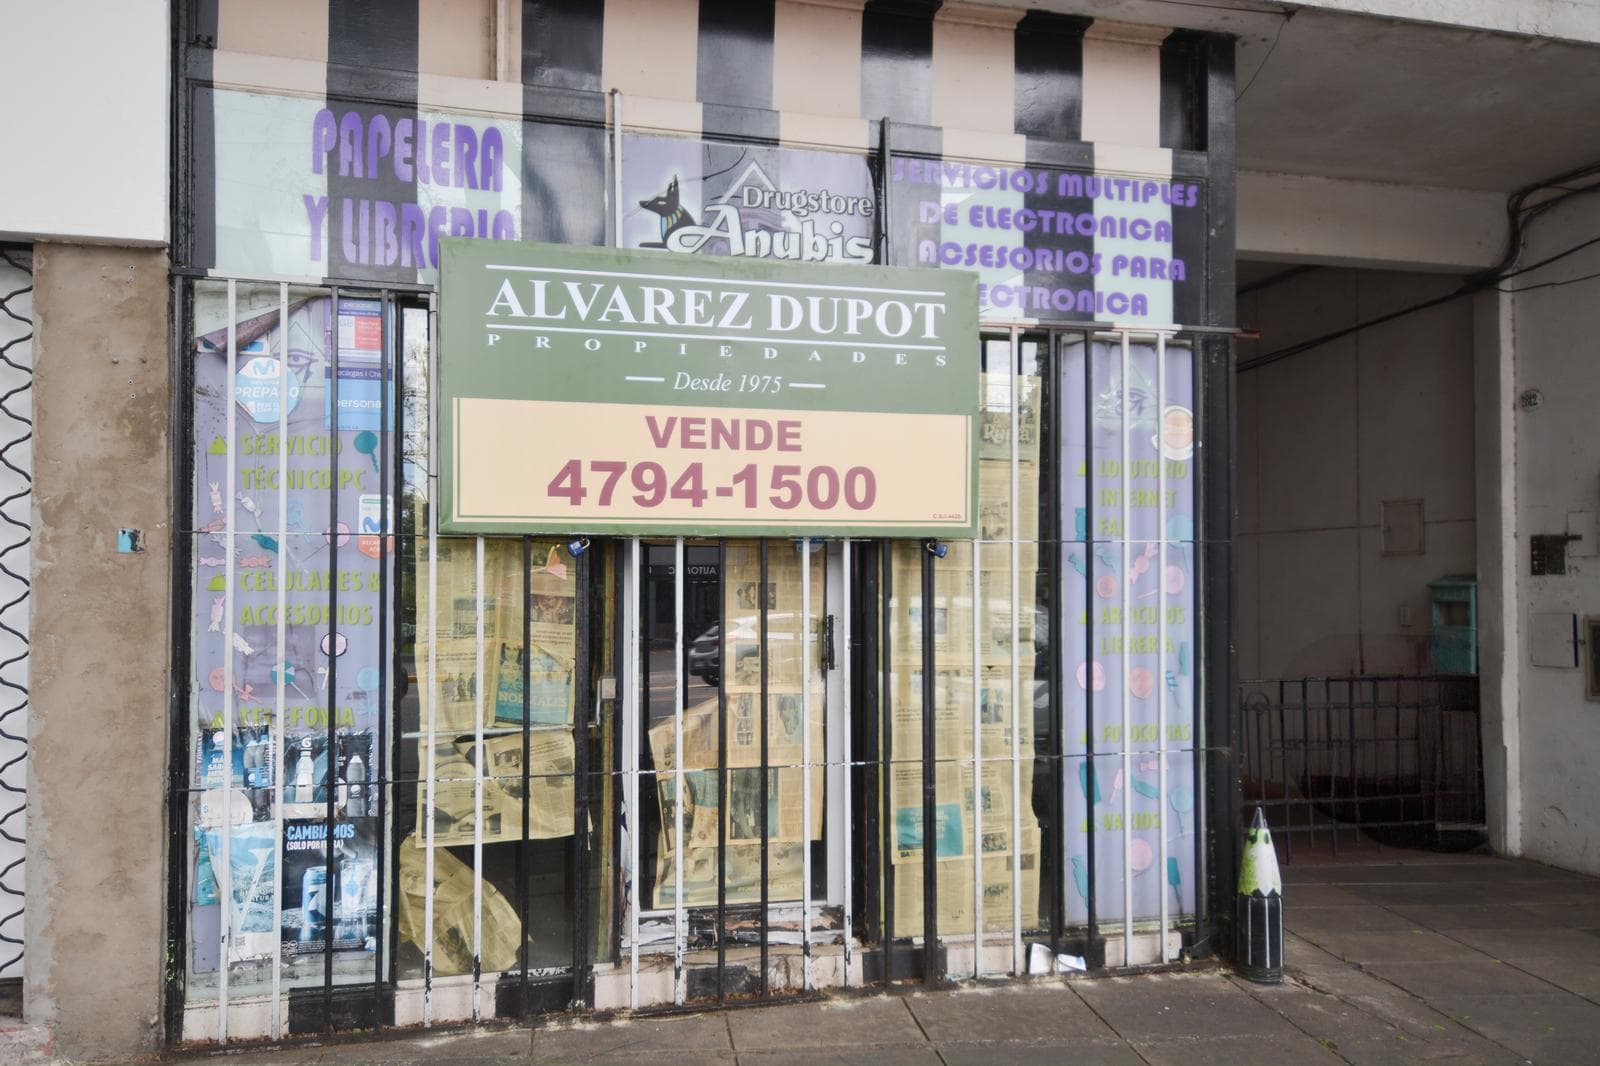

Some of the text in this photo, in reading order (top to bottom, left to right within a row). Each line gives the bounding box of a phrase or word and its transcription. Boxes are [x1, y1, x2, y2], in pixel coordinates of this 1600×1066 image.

[311, 107, 504, 192] PAPELERA
[892, 157, 1198, 208] SERVICIOS MULTIPLES
[742, 185, 874, 218] Drugstore
[303, 194, 328, 261] Y
[666, 203, 874, 265] Anubis
[919, 200, 1172, 243] DE ELECTRONICA
[919, 240, 1186, 281] ACSESORIOS PARA
[486, 277, 946, 339] ALVAREZ DUPOT
[979, 283, 1148, 317] ECTRONICA
[487, 333, 947, 367] PROPIEDADES
[236, 386, 300, 398] PREPAO
[673, 371, 783, 394] Desde 1975
[338, 399, 382, 410] ersona
[644, 415, 803, 453] VENDE
[339, 466, 367, 490] PC
[547, 459, 878, 511] 4794-1500
[1098, 459, 1186, 479] LOUTOIO
[1099, 515, 1124, 536] FA
[1101, 606, 1185, 624] ARICUOS
[1103, 722, 1191, 742] FOOCOIAS
[1103, 811, 1161, 832] VAIOS
